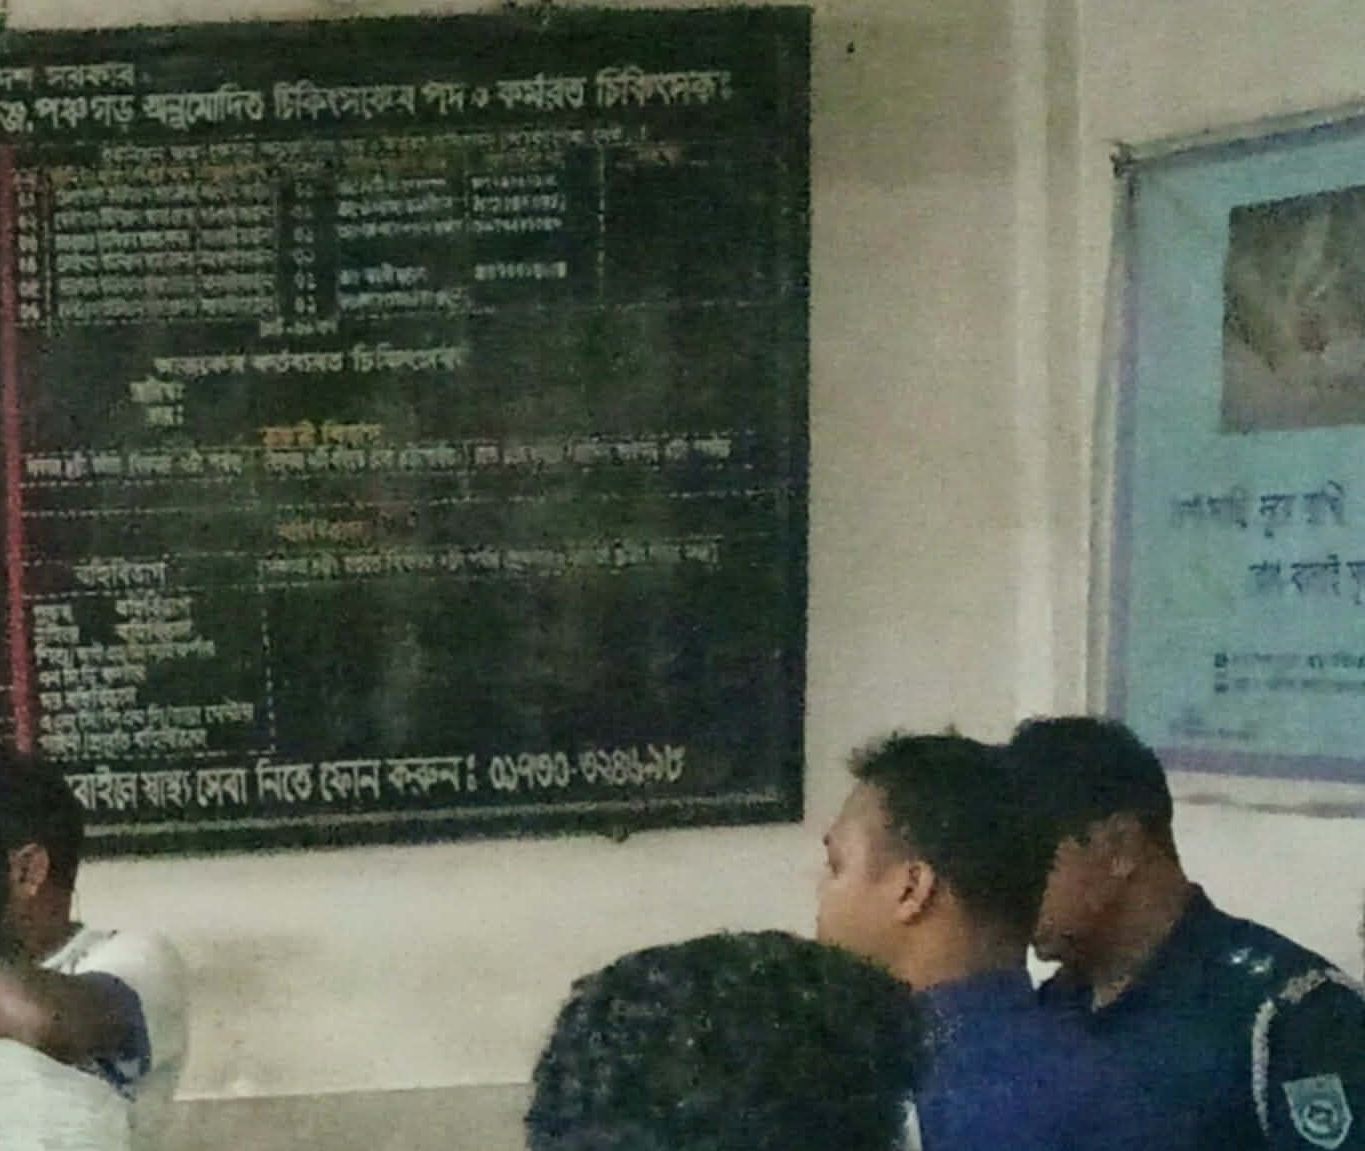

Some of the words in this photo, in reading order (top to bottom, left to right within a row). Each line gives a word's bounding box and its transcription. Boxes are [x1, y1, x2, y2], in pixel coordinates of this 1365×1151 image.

[45, 61, 135, 90] সরকার
[420, 80, 466, 115] পদ
[496, 73, 588, 112] কর্মরত
[64, 763, 138, 811] বাইলে
[197, 767, 248, 807] সেবা
[256, 757, 313, 803] নিতে
[319, 759, 382, 802] ফোন
